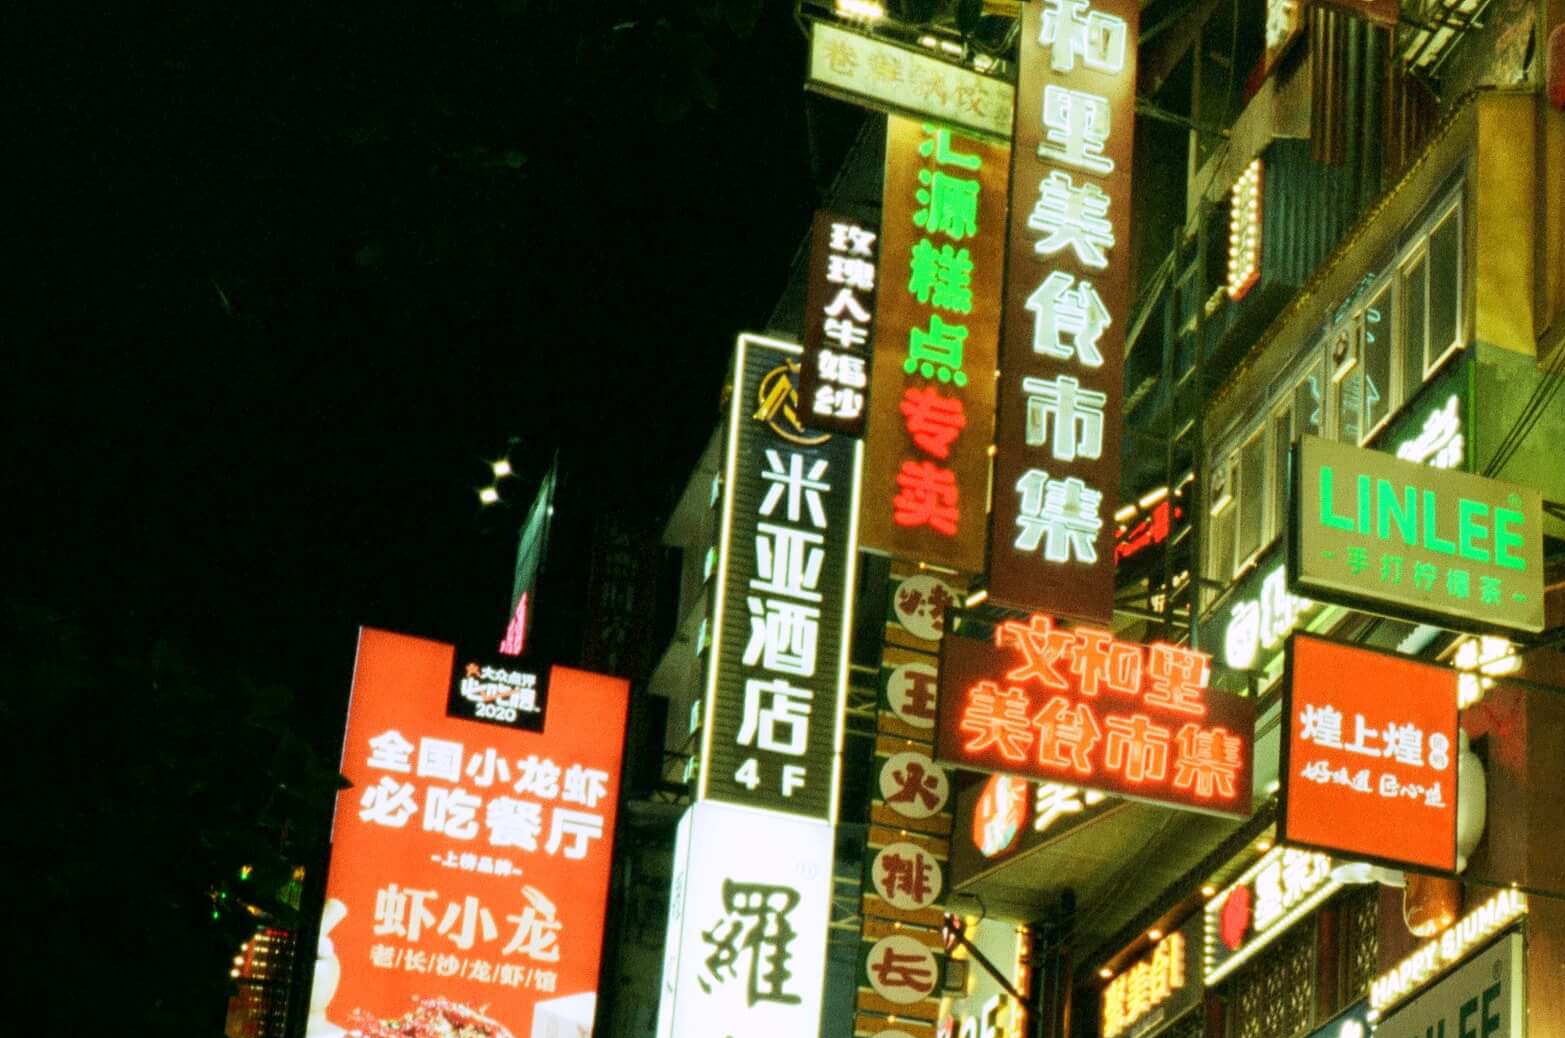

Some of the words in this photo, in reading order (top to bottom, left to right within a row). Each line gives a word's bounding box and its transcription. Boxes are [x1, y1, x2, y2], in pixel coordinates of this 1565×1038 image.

[1320, 466, 1527, 571] LINLEE
[735, 447, 832, 757] 米亚酒店
[1005, 616, 1210, 714] 文和里
[475, 702, 517, 723] 2020
[961, 683, 1243, 798] 美食市集
[1299, 702, 1424, 767] 煌上煌
[366, 729, 609, 808] 全国小龙虾
[358, 775, 604, 860] 必吃餐厅
[373, 882, 562, 965] 虾小龙
